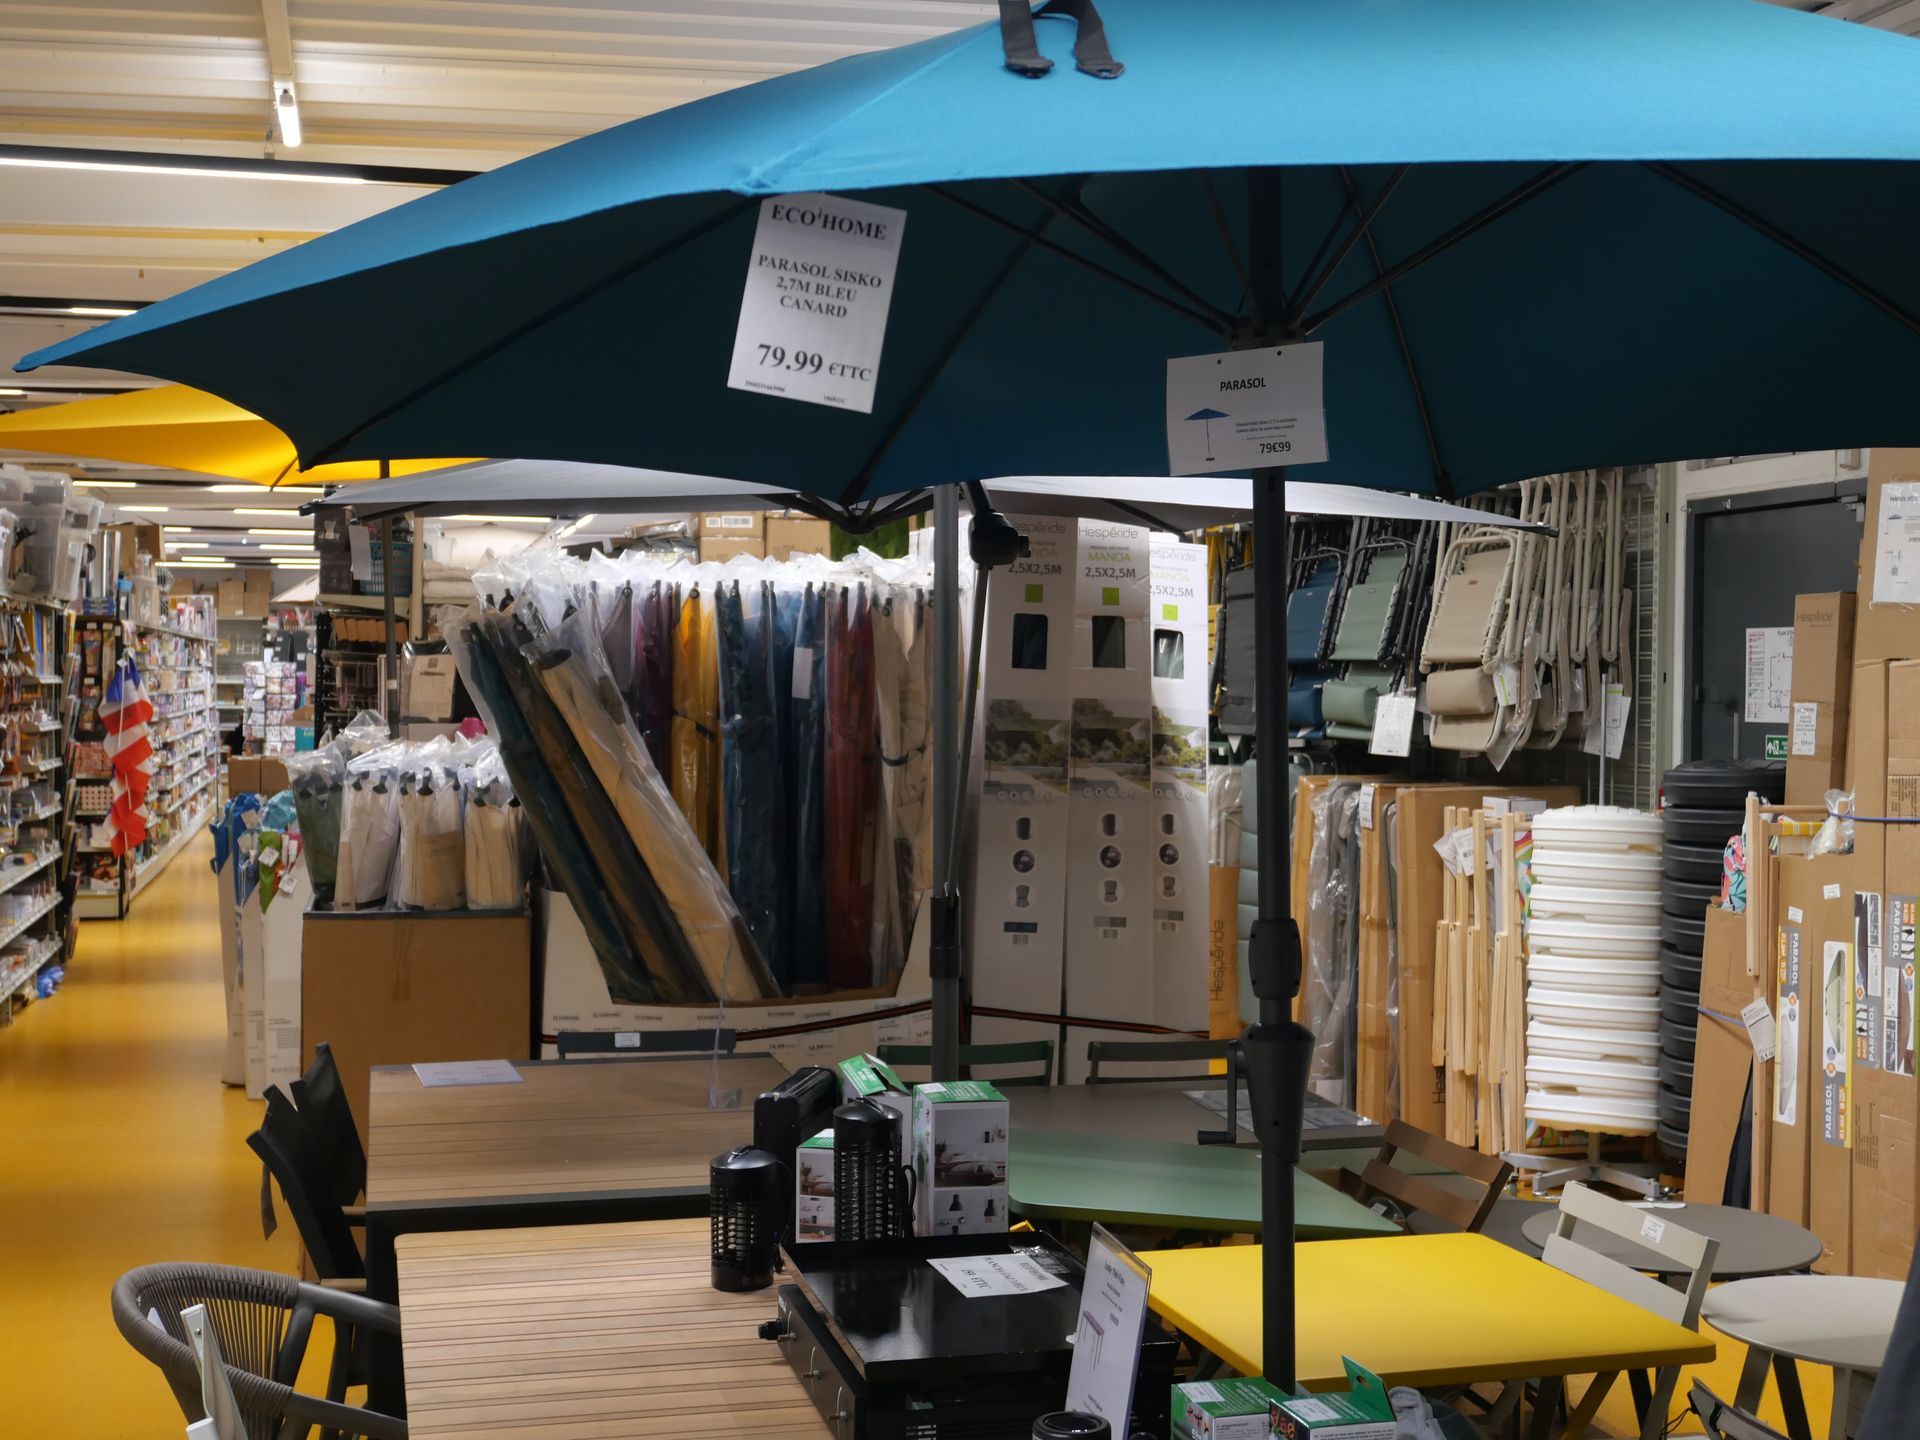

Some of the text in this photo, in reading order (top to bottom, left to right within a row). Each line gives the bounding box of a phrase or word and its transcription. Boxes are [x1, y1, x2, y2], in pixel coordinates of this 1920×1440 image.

[771, 204, 887, 241] ECO'HOME
[758, 254, 882, 289] PARASOL SISKO
[775, 276, 857, 302] 2,7M BLEU
[780, 294, 847, 318] CANARD
[757, 343, 872, 382] 79.99 €TTC
[1219, 377, 1266, 392] PARASOL
[1259, 441, 1291, 454] 79€99
[1014, 520, 1066, 536] espéride
[1078, 525, 1138, 540] Hespéride
[1150, 548, 1196, 562] espéride
[1008, 562, 1062, 576] 2,5X2,5M
[1085, 566, 1136, 580] 2,5X2,5M
[1892, 900, 1901, 959] PARASOL
[1209, 920, 1226, 1001] Hespéride
[1791, 932, 1799, 987] PARASOL
[1825, 1083, 1833, 1139] PARASOL
